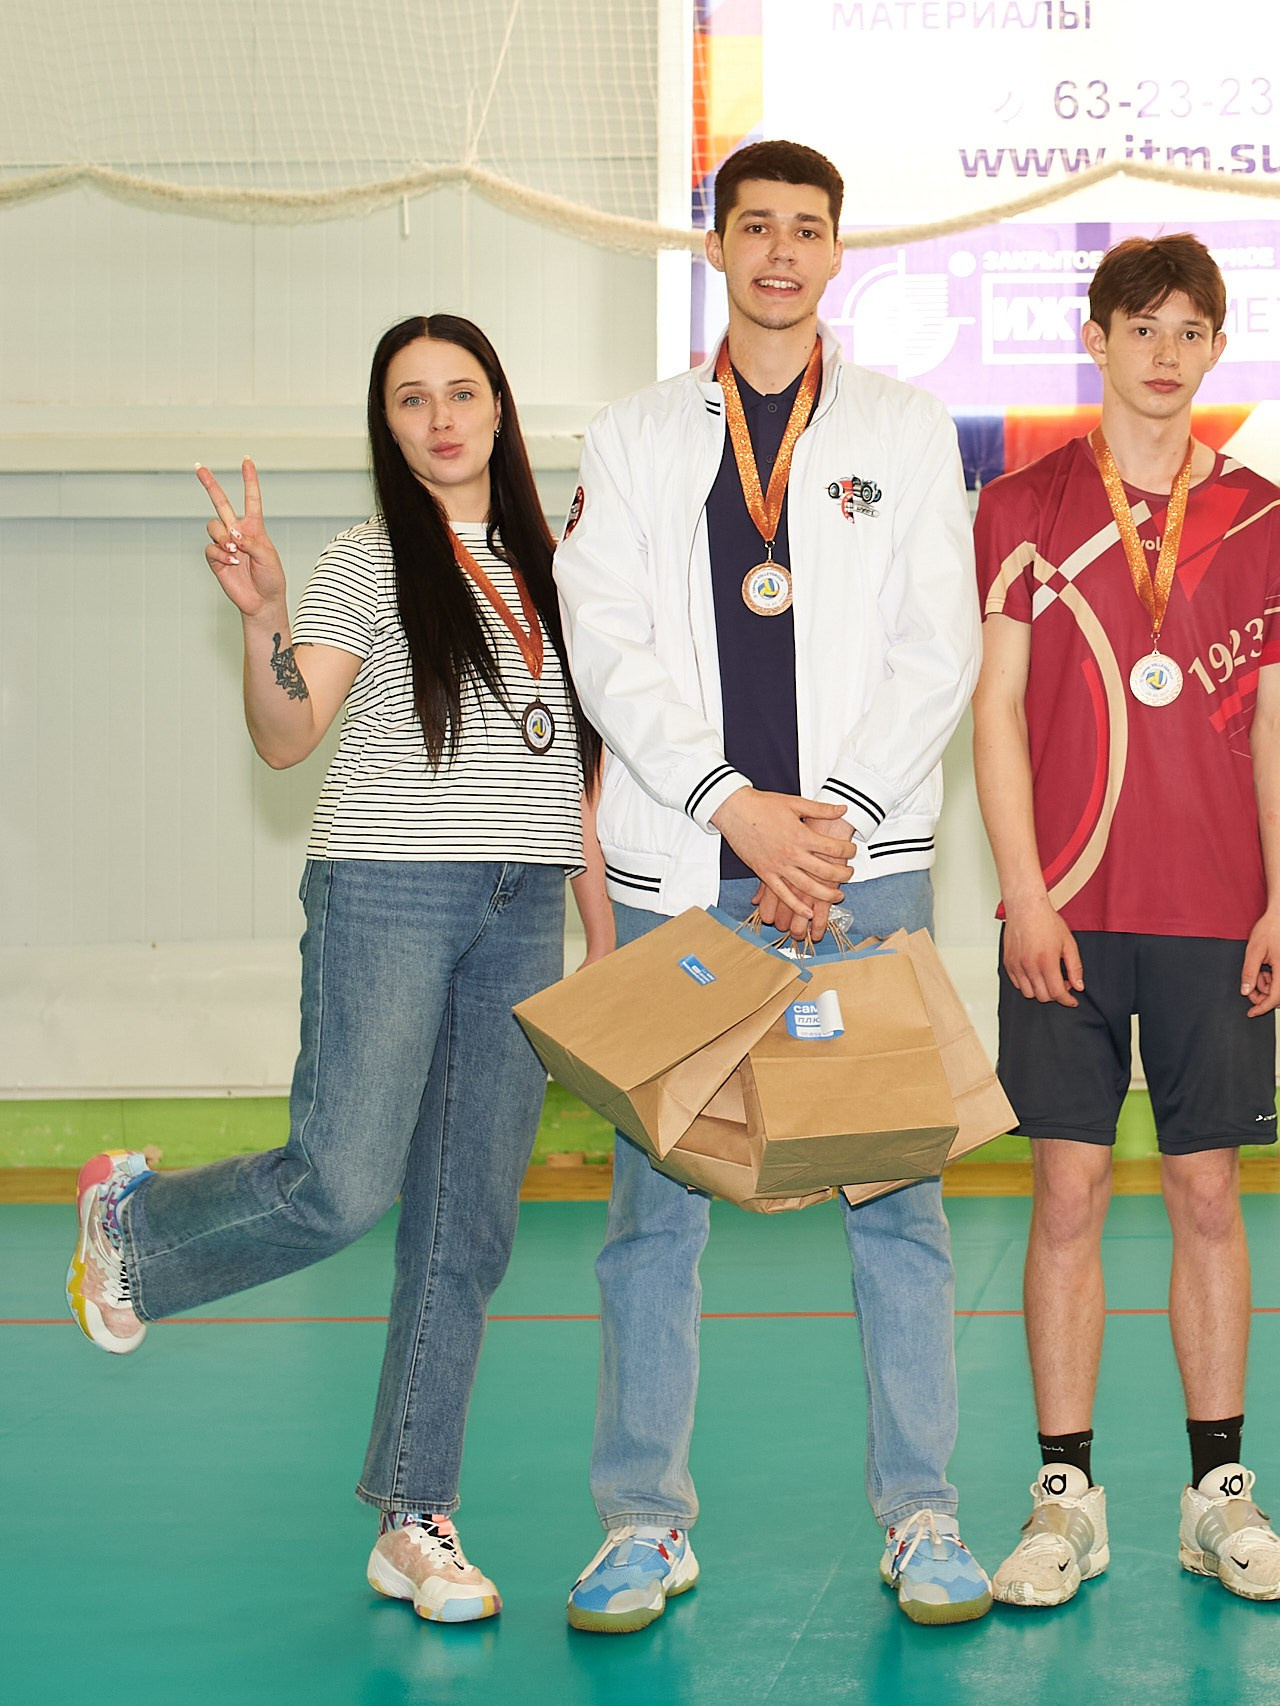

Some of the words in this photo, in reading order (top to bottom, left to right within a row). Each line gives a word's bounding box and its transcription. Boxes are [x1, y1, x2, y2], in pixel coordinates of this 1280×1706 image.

[831, 0, 1092, 31] МАТЕРИАЛЫ
[1053, 77, 1274, 120] 63-23-23
[1187, 617, 1264, 695] 1923
